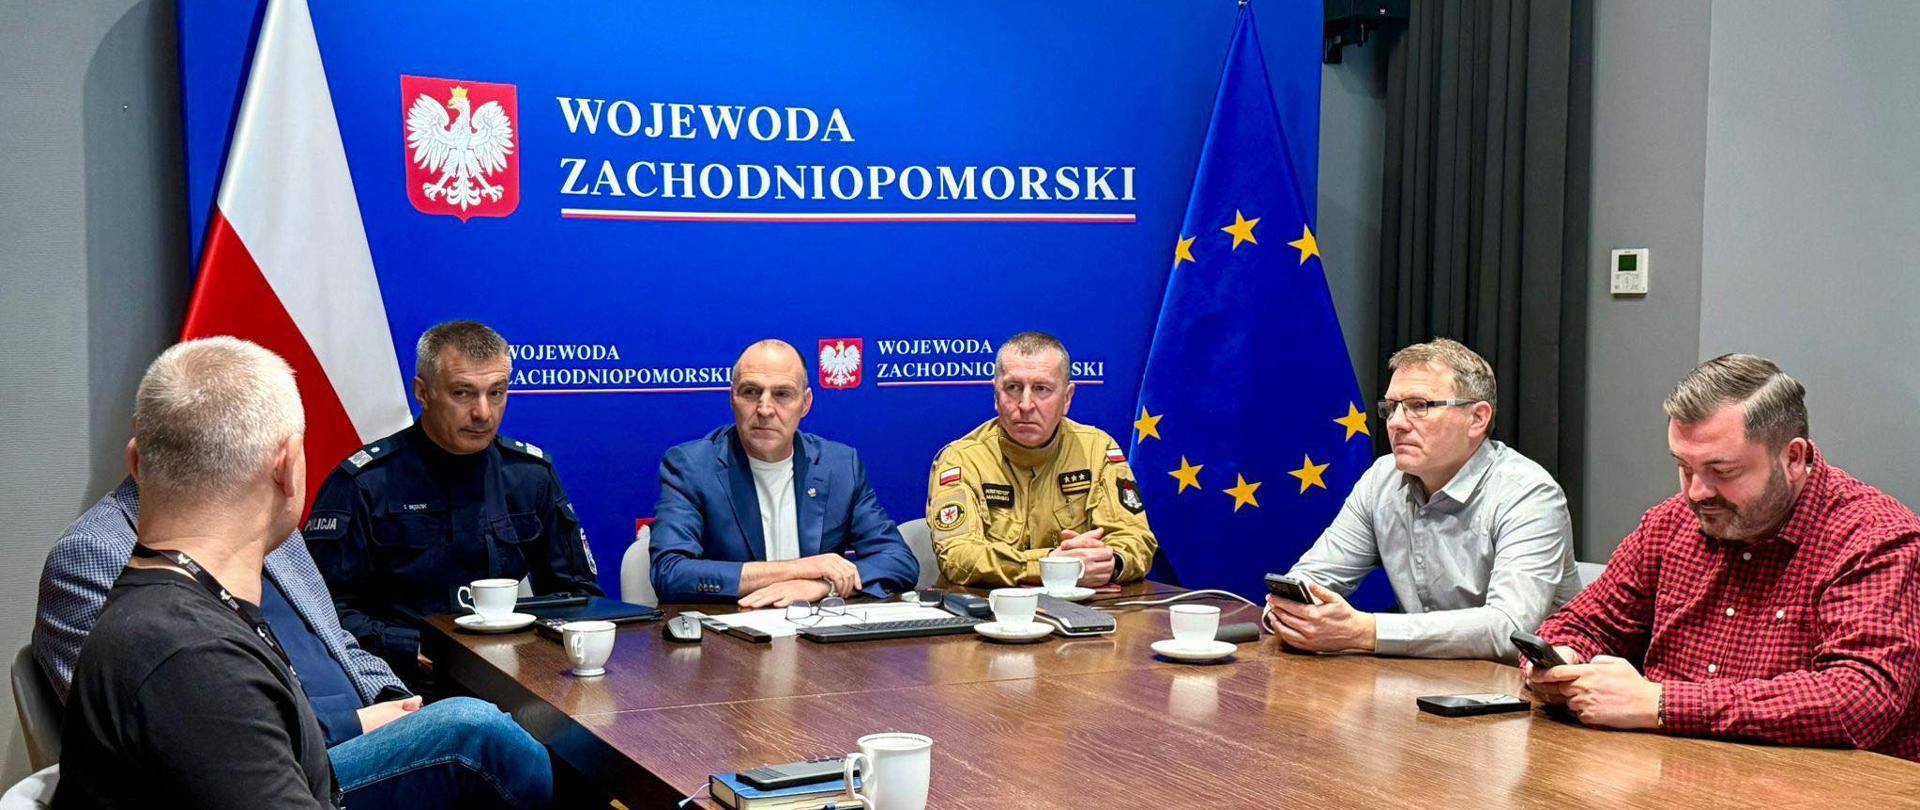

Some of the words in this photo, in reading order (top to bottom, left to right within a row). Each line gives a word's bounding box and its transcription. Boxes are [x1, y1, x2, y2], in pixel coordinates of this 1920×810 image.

[556, 96, 855, 143] WOJEWODA
[558, 157, 1137, 202] ZACHODNIOPOMORSKI
[508, 344, 620, 360] WOJEWODA
[877, 339, 993, 355] WOJEWODA
[877, 361, 1104, 378] ZACHODNIOSKI
